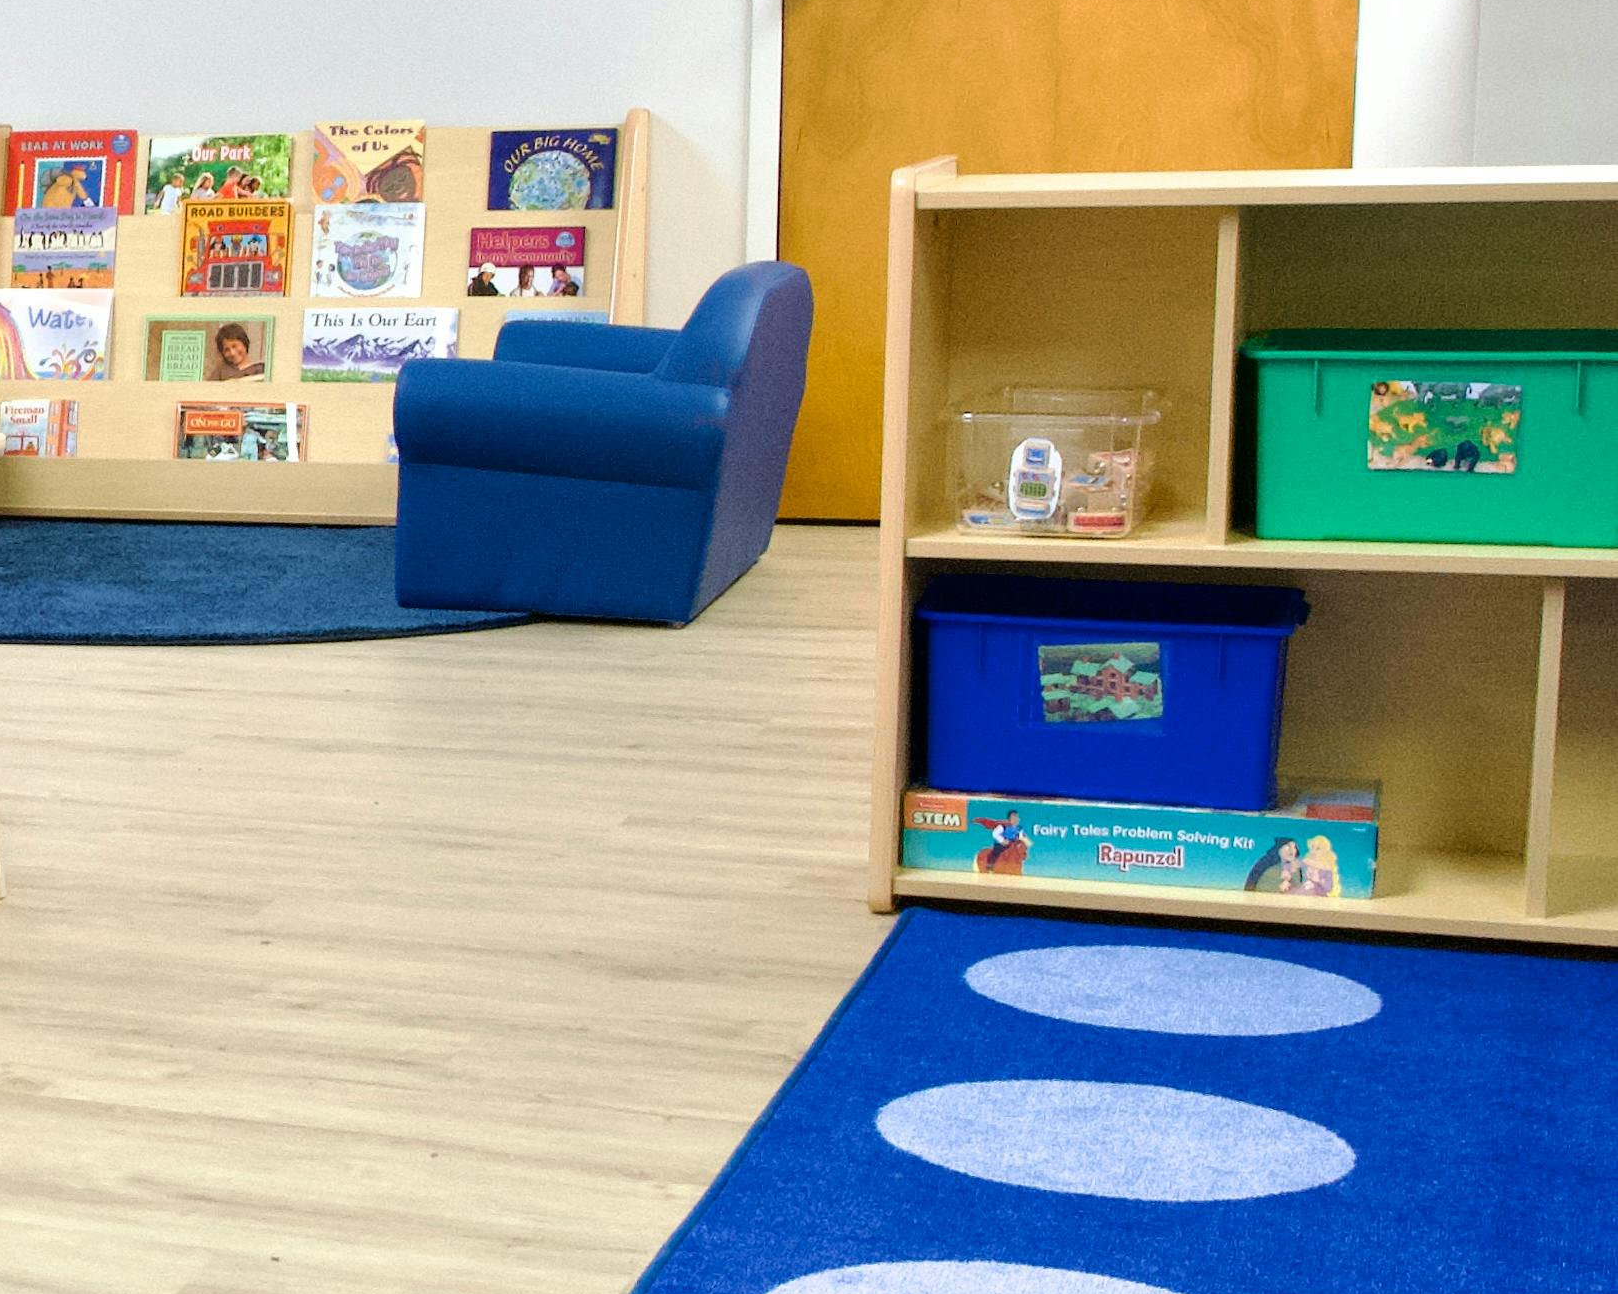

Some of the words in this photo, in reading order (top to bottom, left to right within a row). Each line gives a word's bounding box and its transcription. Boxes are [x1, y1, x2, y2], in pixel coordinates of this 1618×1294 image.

[329, 125, 359, 136] The
[363, 125, 414, 136] Colors
[21, 141, 49, 152] BEAR
[53, 140, 66, 151] AT
[70, 140, 104, 151] WORK
[351, 141, 369, 152] of
[372, 141, 389, 151] Us
[192, 146, 218, 162] Our
[220, 145, 251, 161] Park
[504, 143, 531, 174] OUR
[534, 135, 560, 150] BIG
[563, 138, 604, 171] HOME
[191, 207, 224, 217] ROAD
[228, 206, 285, 217] BUILDERS
[477, 231, 550, 253] Helpers
[512, 250, 576, 264] community
[312, 313, 344, 327] This
[351, 313, 363, 327] Is
[369, 313, 398, 326] Our
[404, 312, 437, 327] Eart
[168, 344, 200, 352] BREAD
[167, 362, 198, 370] BREAD
[5, 406, 44, 415] Fireman
[10, 415, 38, 424] Small
[913, 811, 961, 827] STEM
[1033, 823, 1068, 838] Fairy
[1073, 824, 1109, 837] Tales
[1113, 825, 1172, 841] Problem
[1177, 830, 1229, 848] Solving
[1234, 835, 1255, 850] Kit
[1098, 842, 1185, 872] Rapunzel
